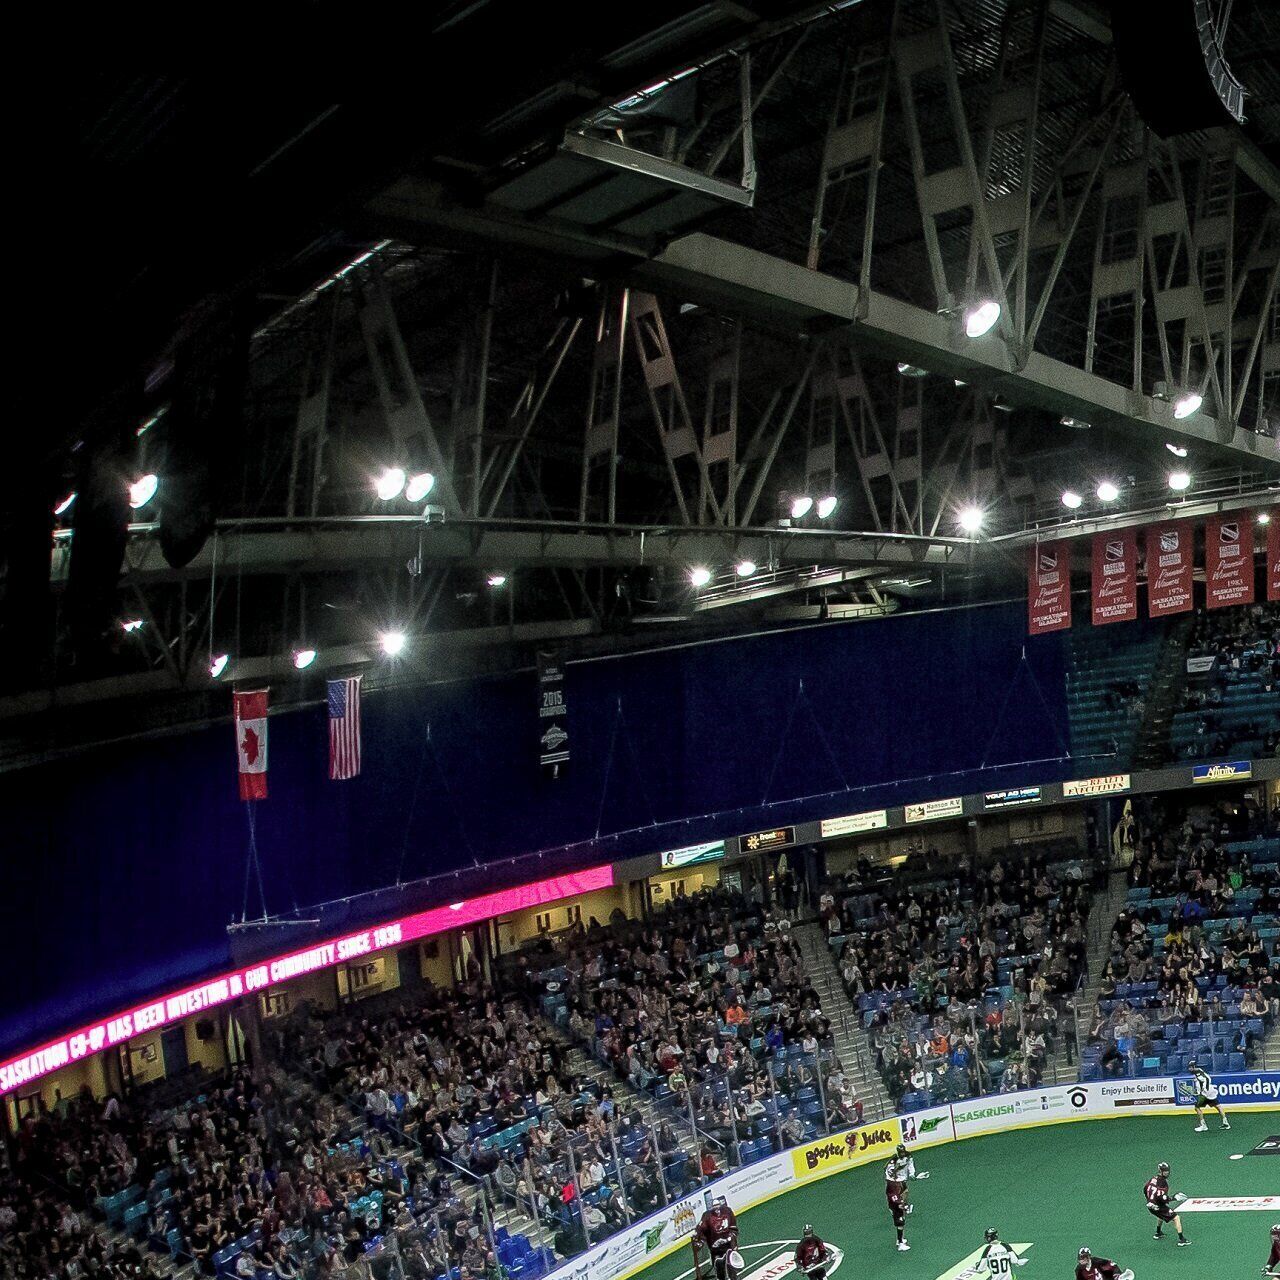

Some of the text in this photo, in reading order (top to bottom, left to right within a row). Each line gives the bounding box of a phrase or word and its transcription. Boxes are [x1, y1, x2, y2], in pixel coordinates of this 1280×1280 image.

[1207, 765, 1236, 779] Affinity
[1068, 782, 1124, 794] EXECUTIVES
[1089, 776, 1125, 786] REALTY
[986, 788, 1040, 800] YOUR AD HERE
[0, 1041, 69, 1091] SASKATOON
[69, 1026, 105, 1059] CO-OP
[107, 1015, 133, 1043] HAS
[166, 980, 228, 1020] INVESTING
[337, 933, 371, 960] SINCE
[1102, 1083, 1168, 1096] Enjoy the Suite life
[1213, 1079, 1280, 1098] someday
[954, 1105, 1014, 1123] #SASKRUSH
[806, 1129, 892, 1170] Booster Juice
[990, 1258, 1009, 1275] 90
